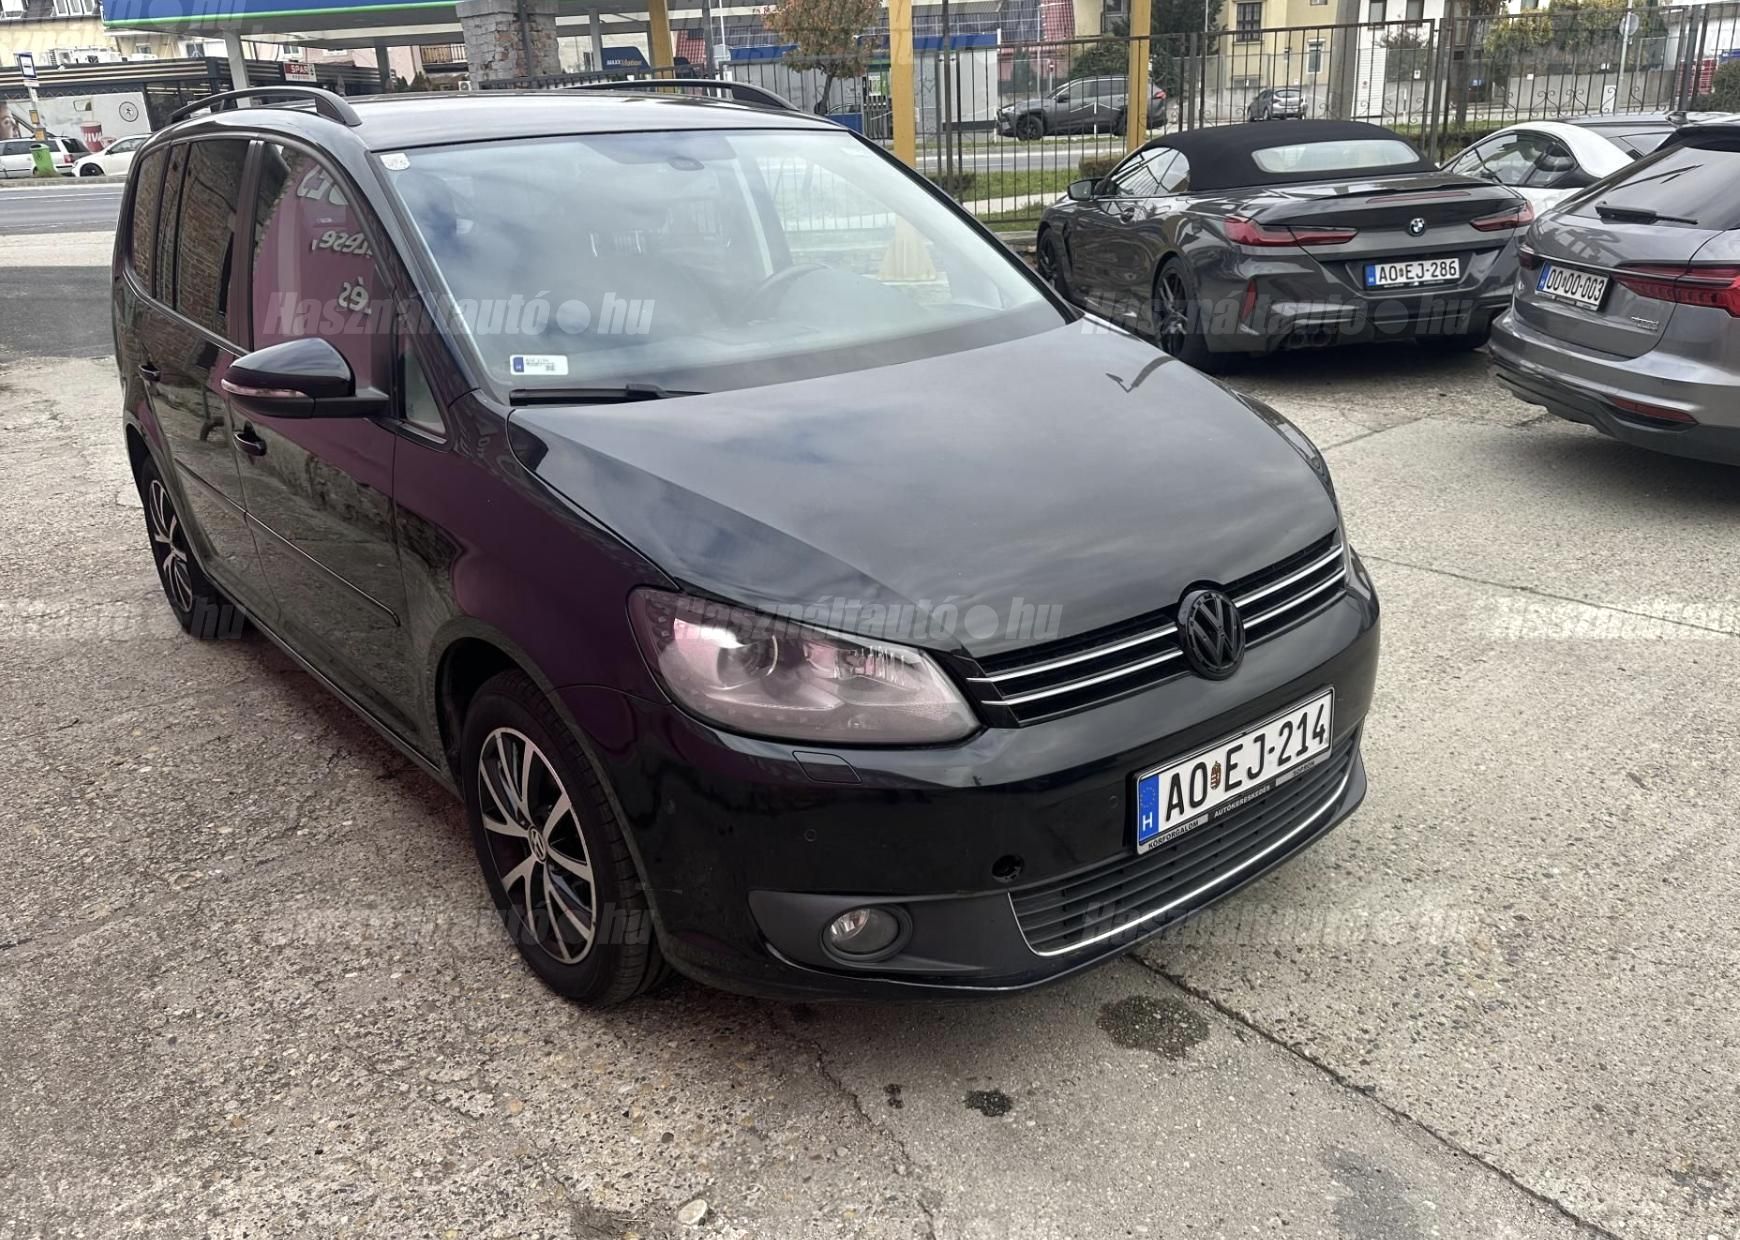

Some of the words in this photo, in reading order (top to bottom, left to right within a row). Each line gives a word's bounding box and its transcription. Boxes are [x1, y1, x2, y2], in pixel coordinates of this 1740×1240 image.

[1405, 260, 1457, 280] EJ-286
[1141, 812, 1154, 831] H
[1166, 762, 1209, 822] AO
[1224, 703, 1327, 793] EJ-214
